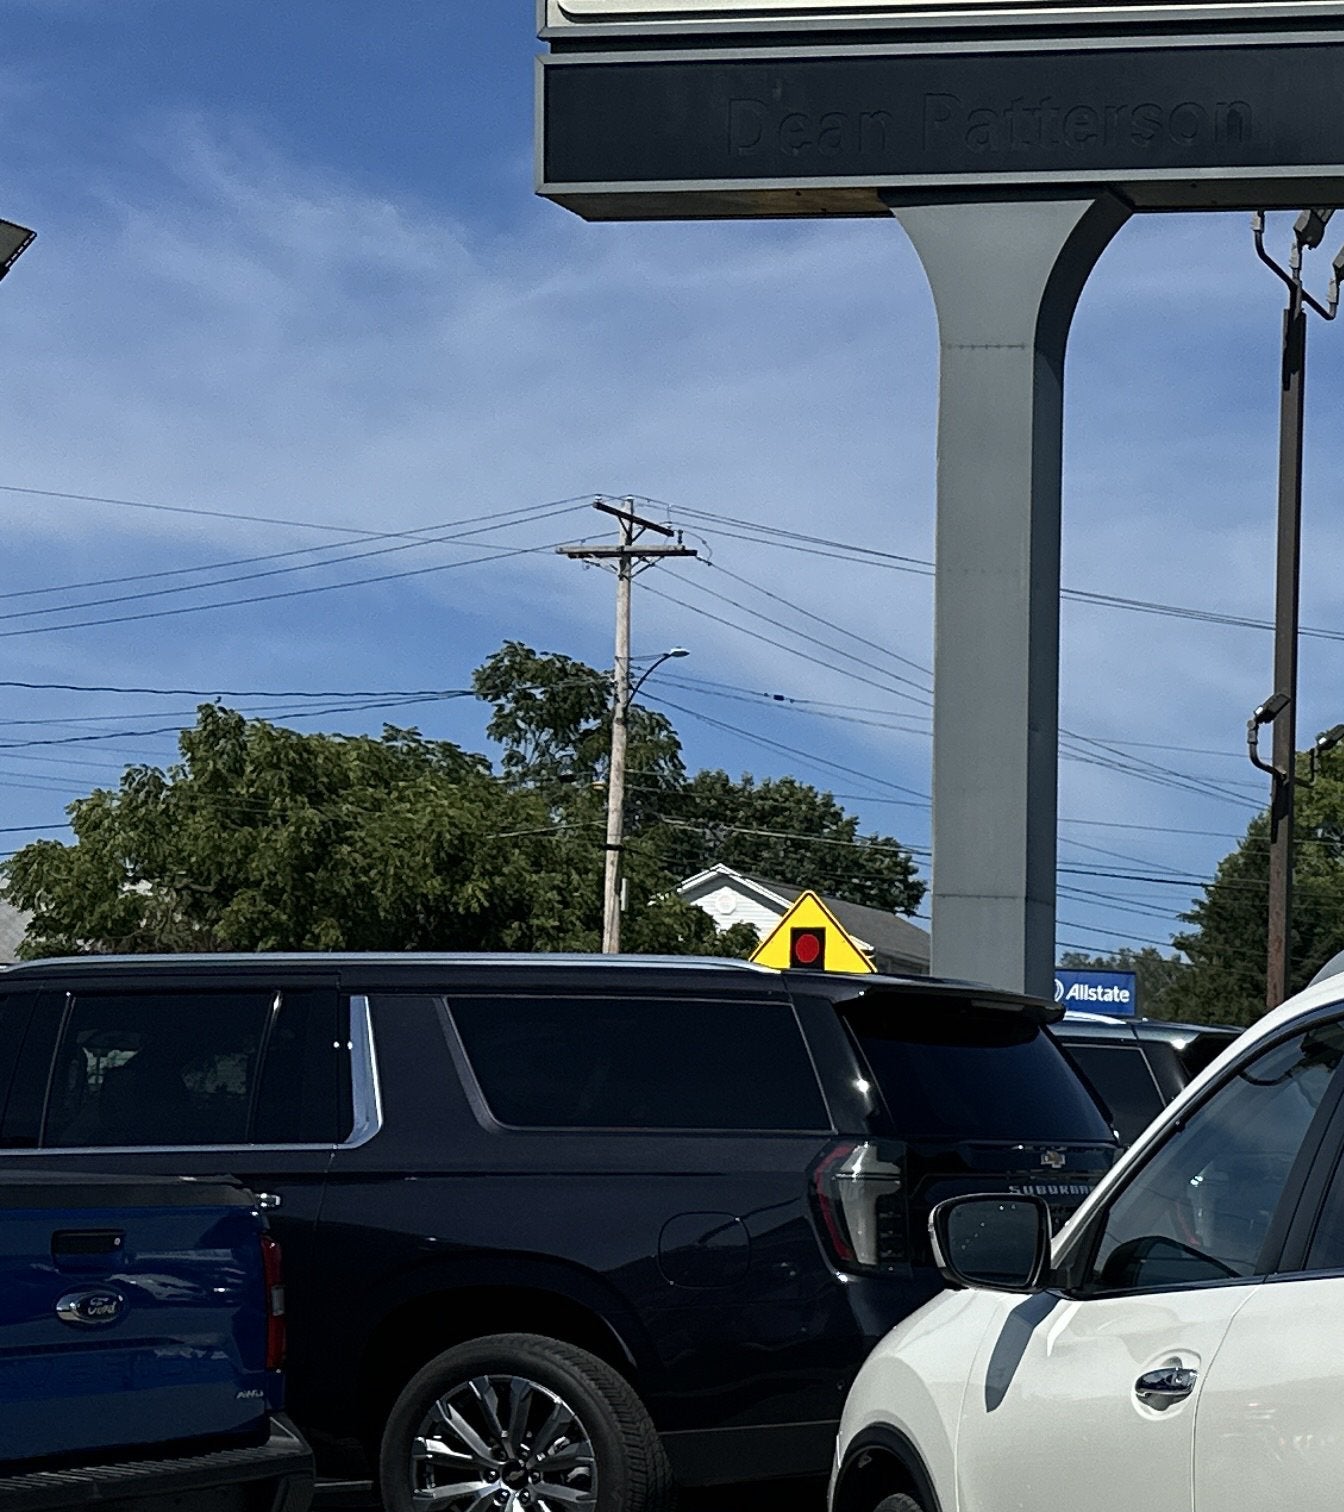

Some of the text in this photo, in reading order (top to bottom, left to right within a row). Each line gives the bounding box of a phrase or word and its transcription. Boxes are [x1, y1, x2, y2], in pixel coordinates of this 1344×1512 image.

[726, 91, 1255, 157] Dean Patterson
[1065, 983, 1131, 1003] Allstate
[87, 1297, 117, 1315] Ford
